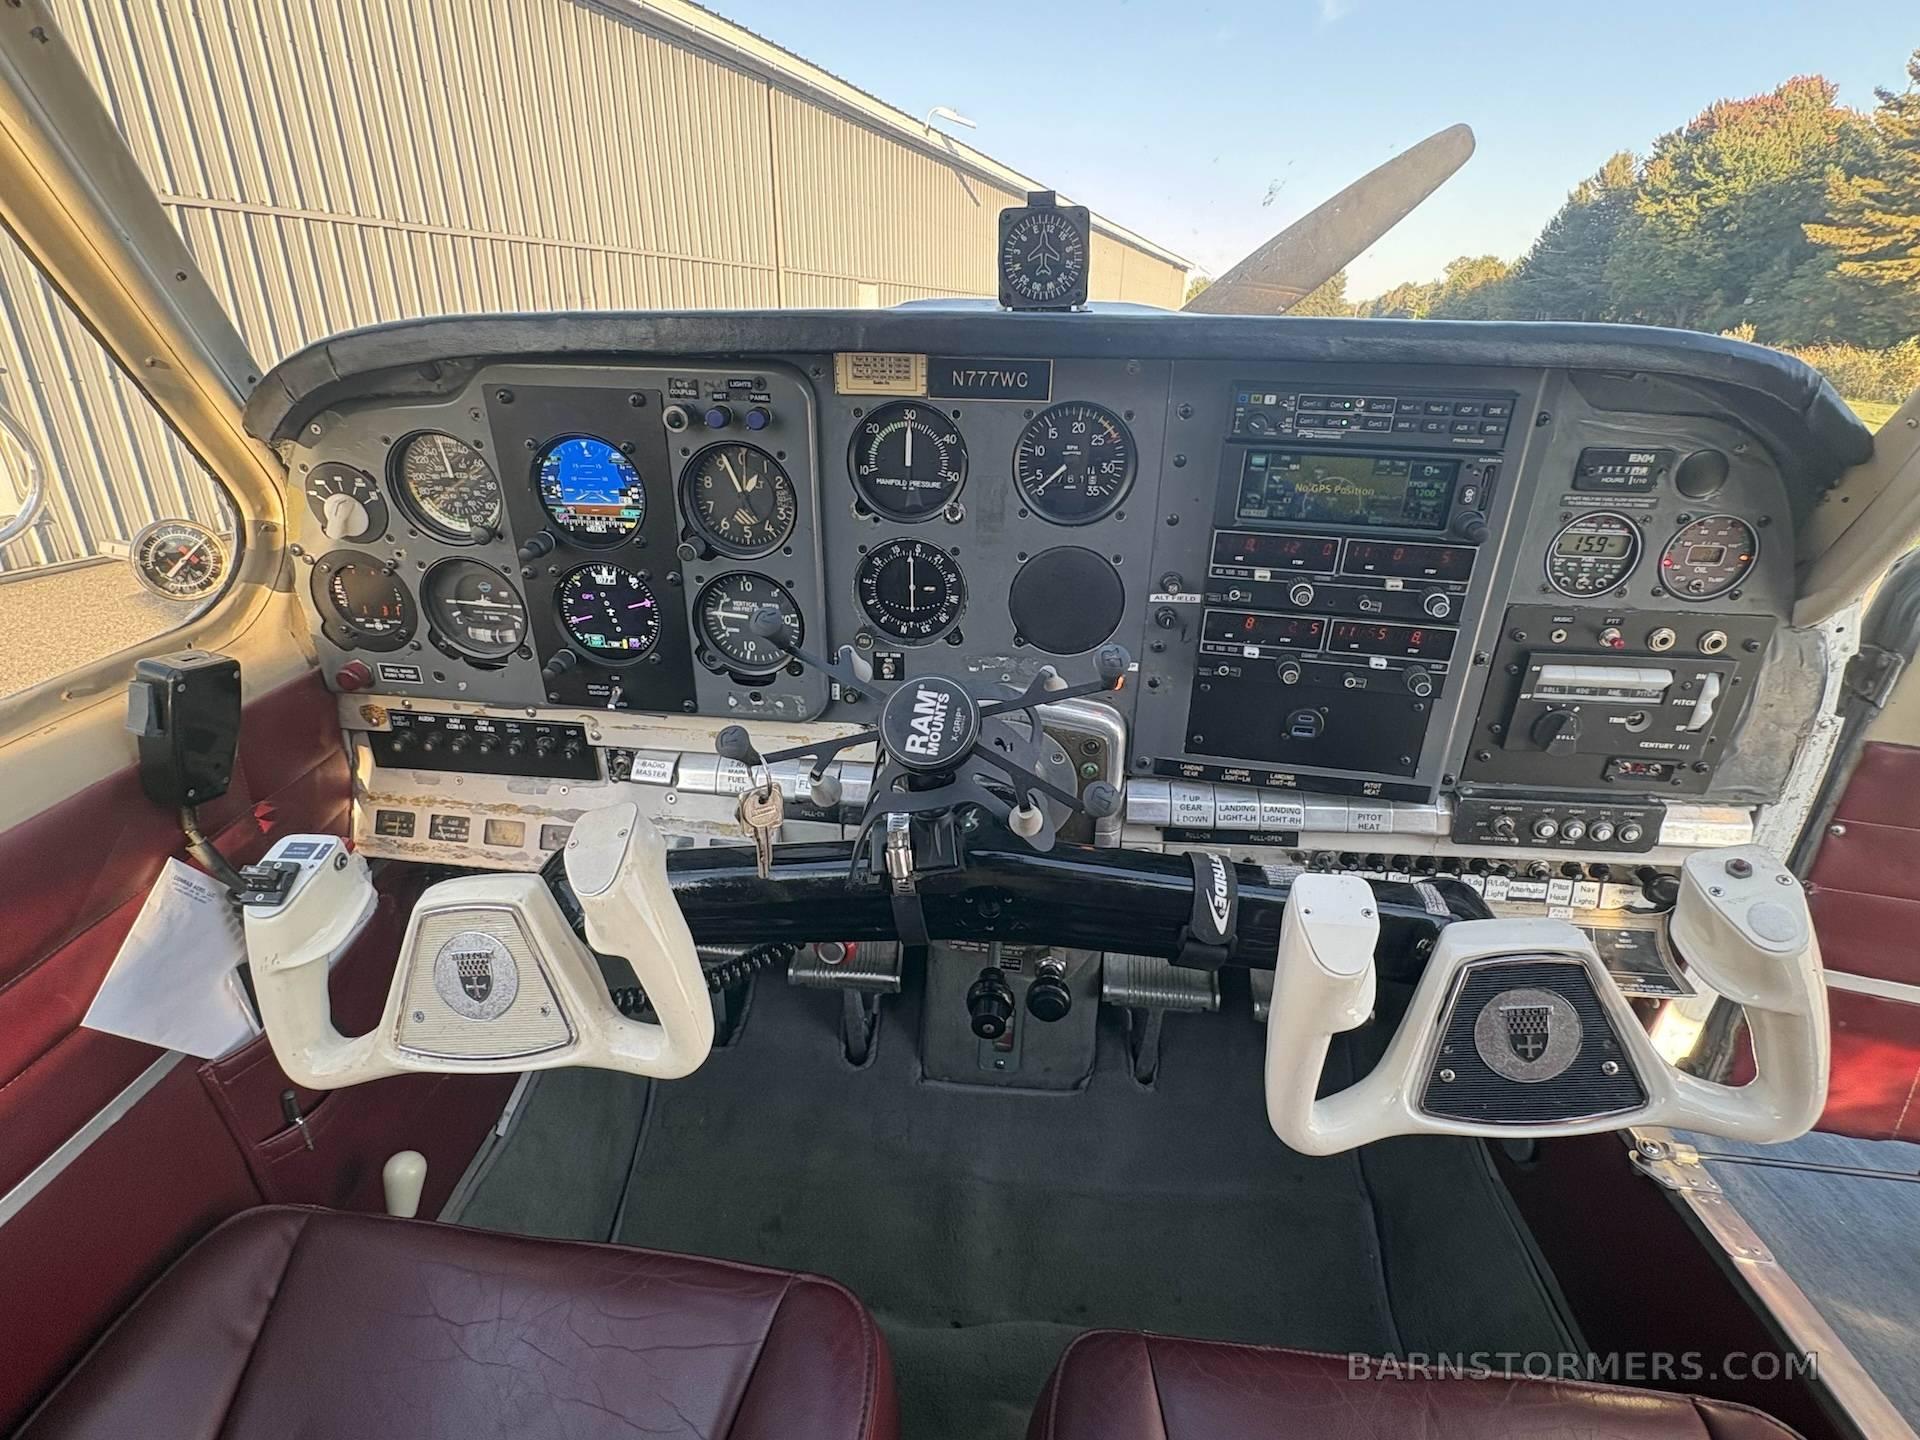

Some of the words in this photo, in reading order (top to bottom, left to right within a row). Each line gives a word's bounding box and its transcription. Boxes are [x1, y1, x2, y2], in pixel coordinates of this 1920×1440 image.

[729, 380, 752, 388] LIGHTS
[952, 370, 1029, 388] N777WC
[904, 409, 916, 420] 30
[866, 423, 879, 433] 20
[1072, 422, 1085, 433] 20
[1048, 428, 1058, 438] 15
[942, 434, 956, 444] 40
[1091, 434, 1104, 446] 25
[1035, 445, 1045, 456] 10
[764, 461, 767, 473] 1
[860, 465, 869, 475] 10
[1100, 463, 1115, 473] 30
[947, 472, 959, 481] 50
[1036, 469, 1043, 480] 5
[486, 482, 496, 490] 80
[704, 476, 712, 488] 8
[775, 476, 783, 488] 2
[876, 478, 908, 486] MANIFOLD
[908, 480, 942, 489] PRESSURE
[1086, 486, 1099, 496] 35
[1295, 484, 1308, 494] No
[1311, 484, 1332, 494] GPS
[1334, 484, 1375, 496] Position
[1415, 489, 1436, 498] 1200
[706, 501, 714, 513] 7
[777, 507, 786, 520] 3
[721, 517, 730, 530] 6
[764, 520, 774, 531] 4
[744, 526, 752, 538] 5
[892, 545, 900, 554] 15
[915, 544, 921, 553] S
[872, 557, 881, 566] 12
[934, 554, 944, 564] 21
[948, 573, 956, 582] 24
[740, 581, 752, 592] 10
[950, 595, 959, 604] W
[939, 613, 949, 623] 30
[900, 625, 907, 634] N
[921, 625, 931, 633] 33
[744, 641, 755, 651] 10
[1672, 698, 1697, 706] PITCH
[904, 690, 938, 754] RAM
[926, 692, 950, 756] MOUNTS
[1640, 741, 1676, 749] CENTURY
[641, 761, 666, 769] RADIO
[1180, 764, 1204, 772] LANDING
[635, 768, 667, 778] MASTER
[1224, 768, 1250, 776] LANDING
[1270, 773, 1296, 781] LANDING
[1180, 804, 1202, 812] GEAR
[1218, 804, 1256, 813] LANDING
[1264, 806, 1302, 816] LANDING
[1182, 815, 1209, 824] DOWN
[1218, 814, 1257, 822] LIGHT-LH
[1262, 814, 1302, 825] LIGHT-RH
[1357, 813, 1383, 822] PITOT
[1358, 823, 1381, 832] HEAT
[1209, 853, 1228, 909] FTRIDE
[1487, 879, 1510, 888] R/Ldg
[1552, 882, 1570, 890] Pitot
[1486, 890, 1504, 898] Light
[1510, 885, 1545, 894] Alternator
[1574, 898, 1596, 906] Lights
